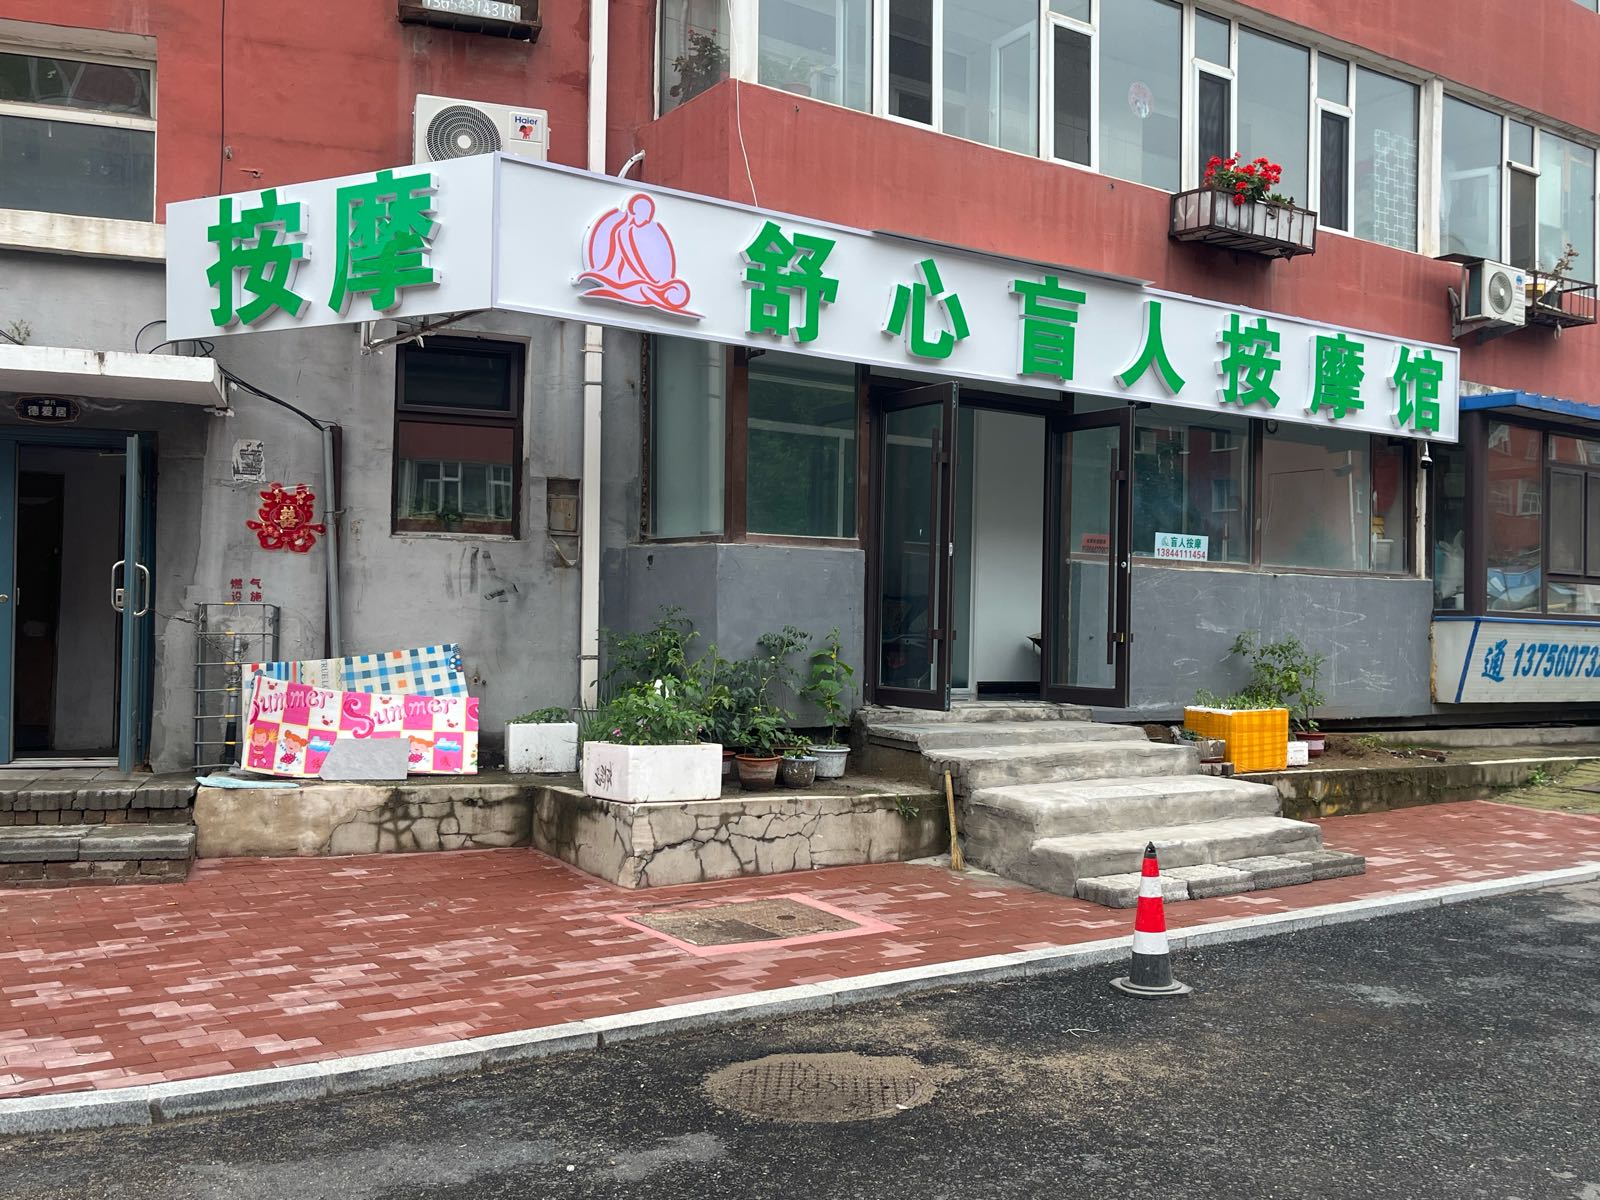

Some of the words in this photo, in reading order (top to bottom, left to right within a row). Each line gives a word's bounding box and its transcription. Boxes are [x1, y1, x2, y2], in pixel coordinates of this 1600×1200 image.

[514, 115, 538, 126] Haier
[205, 169, 435, 327] 按摩
[743, 220, 1444, 433] 舒心盲人按摩馆
[1157, 548, 1206, 559] 13844111454
[1171, 537, 1202, 549] 盲人按摩
[231, 591, 262, 602] 设施
[1481, 638, 1508, 683] 通
[342, 697, 458, 739] Summer
